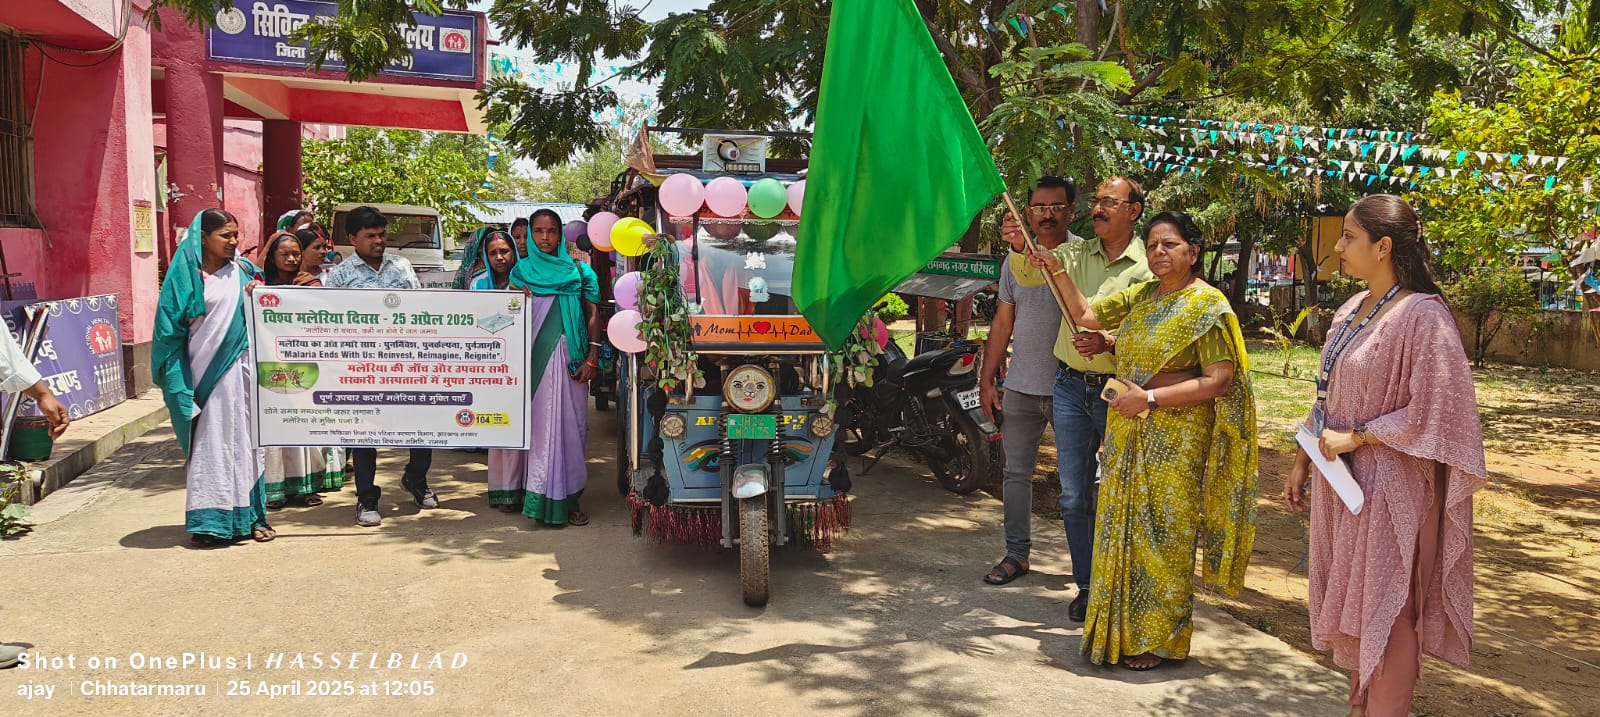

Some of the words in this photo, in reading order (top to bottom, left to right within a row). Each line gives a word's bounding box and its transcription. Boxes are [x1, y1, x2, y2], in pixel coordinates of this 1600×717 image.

[276, 42, 306, 58] जिला
[952, 262, 968, 272] नगर
[262, 310, 293, 323] विश्व
[296, 310, 344, 324] मलेरिया
[346, 310, 380, 324] दिवस
[392, 313, 406, 325] 25
[411, 311, 444, 325] अप्रैल
[447, 313, 474, 325] 2025
[704, 323, 736, 336] Mom
[790, 324, 812, 336] Dad
[278, 339, 308, 348] मलेरिया
[340, 340, 357, 348] हमारे
[378, 352, 415, 360] Reinvest,
[418, 352, 461, 360] Reimagine,
[348, 363, 387, 373] मलेरिया
[391, 363, 403, 373] की
[433, 363, 451, 373] और
[456, 365, 485, 374] उपचार
[488, 364, 509, 374] सभी
[339, 375, 375, 385] सरकारी
[379, 375, 428, 385] अस्पतालों
[431, 375, 440, 385] में
[469, 376, 502, 386] उपलब्ध
[320, 393, 333, 403] पूर्ण
[386, 393, 416, 402] मलेरिया
[419, 394, 426, 402] से
[428, 393, 448, 404] मुक्ति
[964, 400, 981, 408] 30
[282, 416, 308, 424] मलेरिया
[320, 416, 335, 426] मुक्ति
[476, 416, 490, 424] 104
